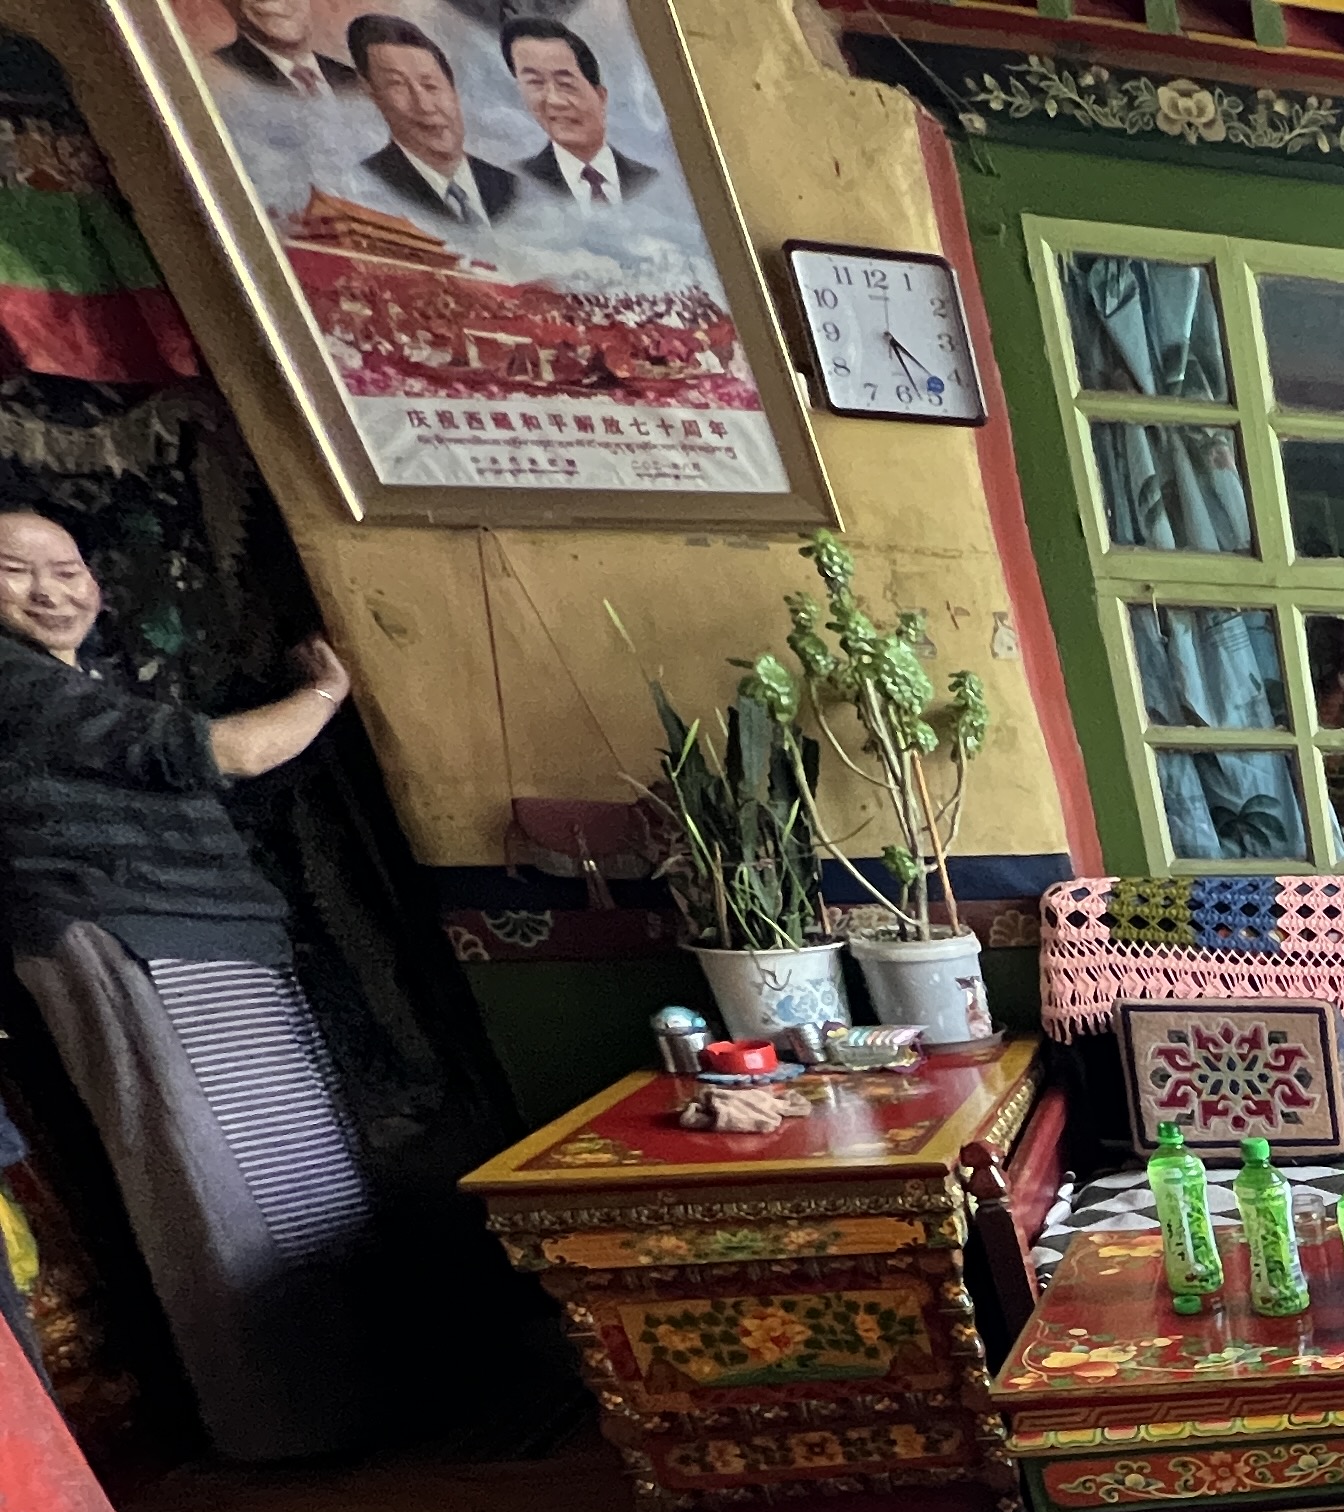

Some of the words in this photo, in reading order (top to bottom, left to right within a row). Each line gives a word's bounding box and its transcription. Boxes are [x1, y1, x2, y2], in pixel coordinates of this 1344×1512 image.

[833, 265, 854, 287] 11
[862, 269, 889, 290] 12
[903, 272, 912, 292] 1
[813, 287, 839, 310] 10
[929, 297, 947, 319] 2
[822, 321, 841, 342] 9
[937, 332, 955, 353] 3
[833, 357, 852, 378] 8
[947, 368, 962, 386] 4
[863, 382, 879, 402] 7
[895, 384, 913, 404] 6
